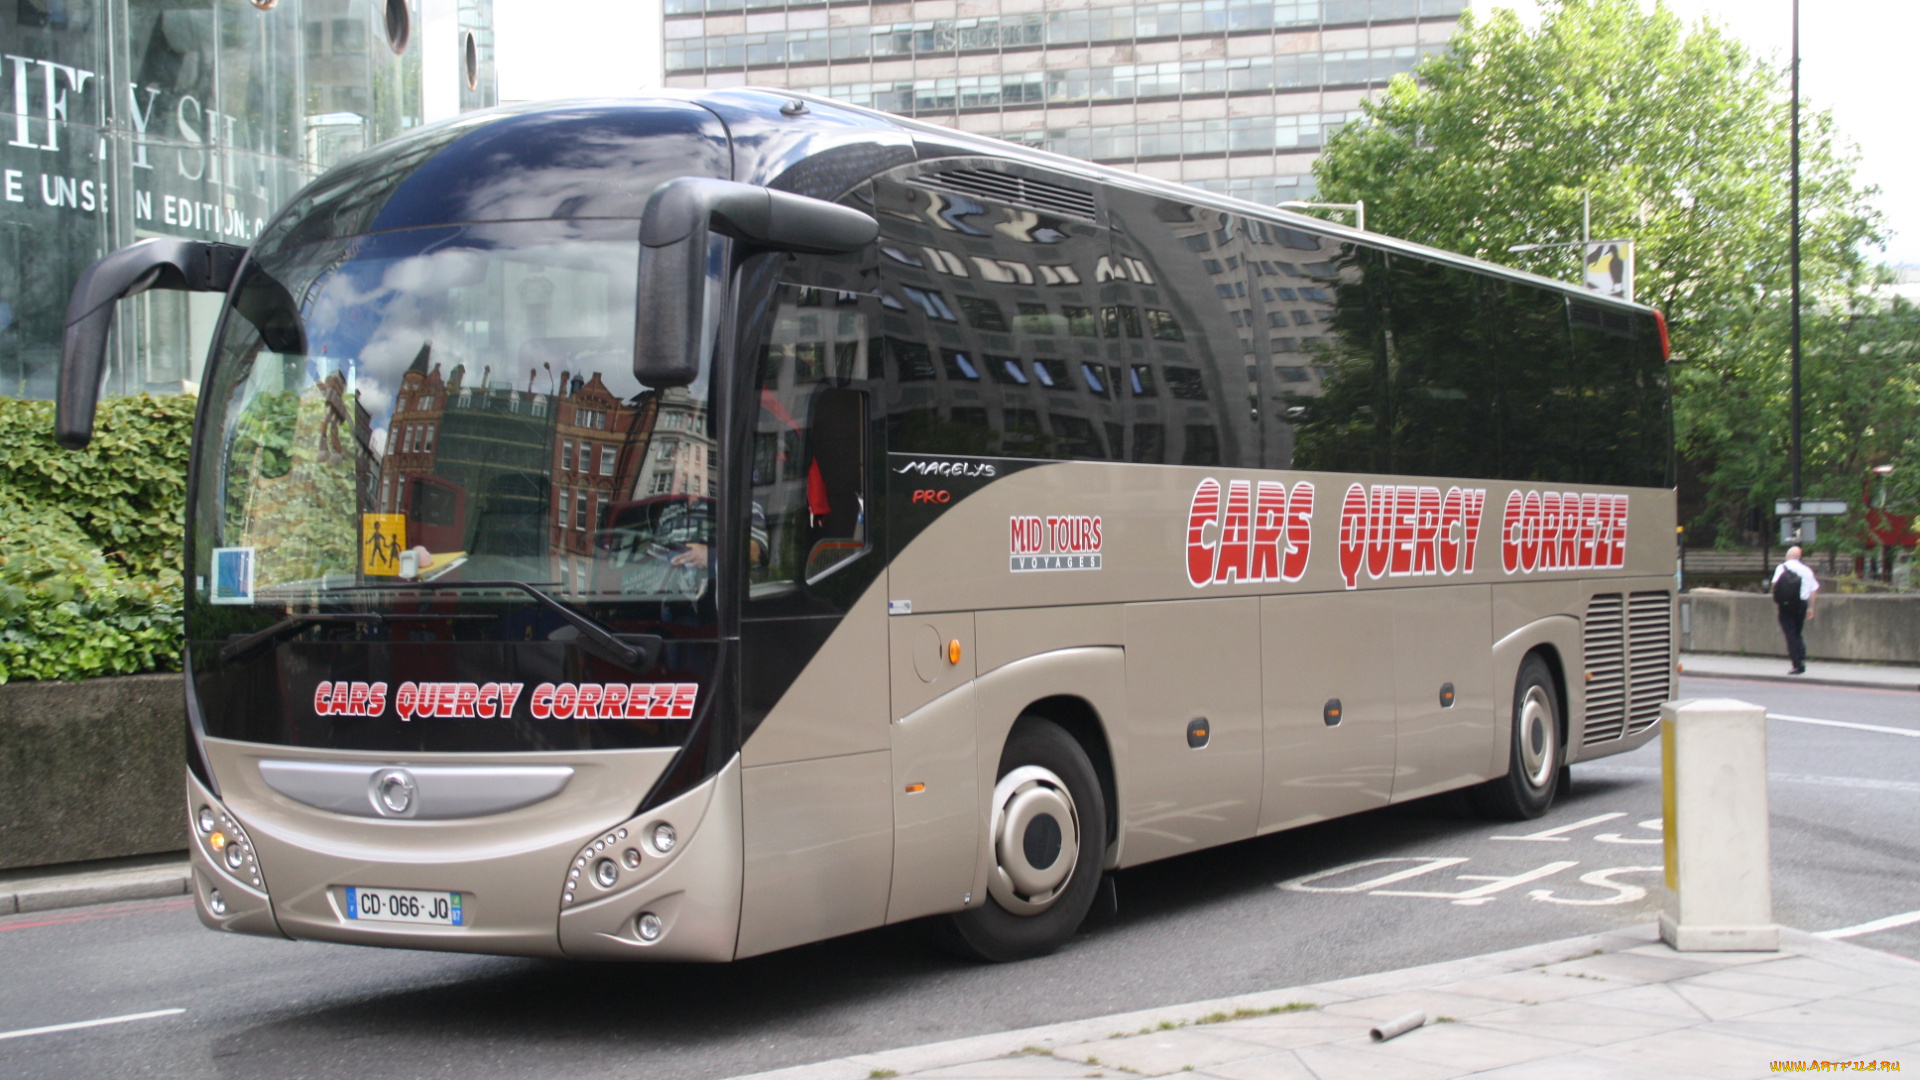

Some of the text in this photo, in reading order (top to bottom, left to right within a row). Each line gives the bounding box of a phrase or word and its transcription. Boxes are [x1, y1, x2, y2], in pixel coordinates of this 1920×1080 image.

[892, 461, 996, 477] MAGELYS
[912, 489, 951, 504] PRO
[1010, 515, 1102, 554] MID TOURS
[1185, 477, 1629, 590] CARS QUERCY CORREZE
[1020, 556, 1095, 569] VOYAGES
[314, 681, 699, 721] CARS QUERCY CORREZE
[452, 910, 461, 921] 87
